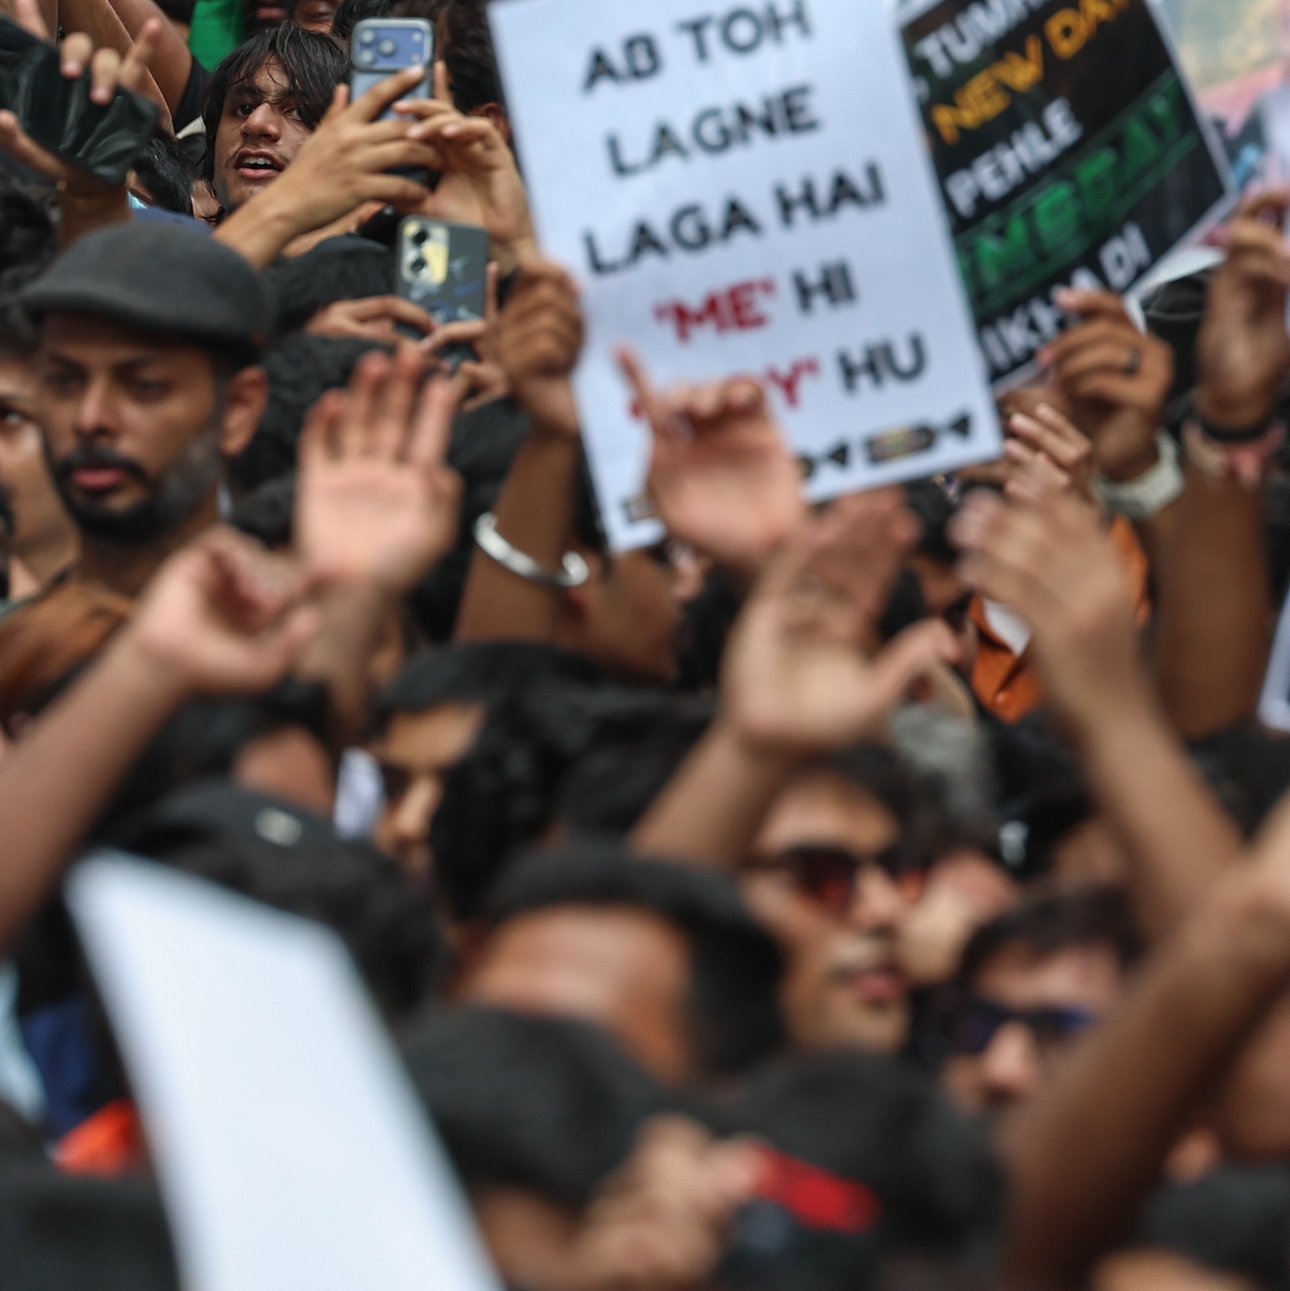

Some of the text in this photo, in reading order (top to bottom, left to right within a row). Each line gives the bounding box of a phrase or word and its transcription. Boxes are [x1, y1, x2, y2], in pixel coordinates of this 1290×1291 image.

[581, 32, 662, 95] AB
[930, 33, 1045, 147] NEW
[606, 82, 822, 177] LAGNE
[944, 96, 1084, 220] PEHLE
[582, 156, 887, 277] LAGA HAI
[1097, 219, 1152, 290] DI
[790, 257, 859, 314] HI
[836, 330, 927, 395] HU
